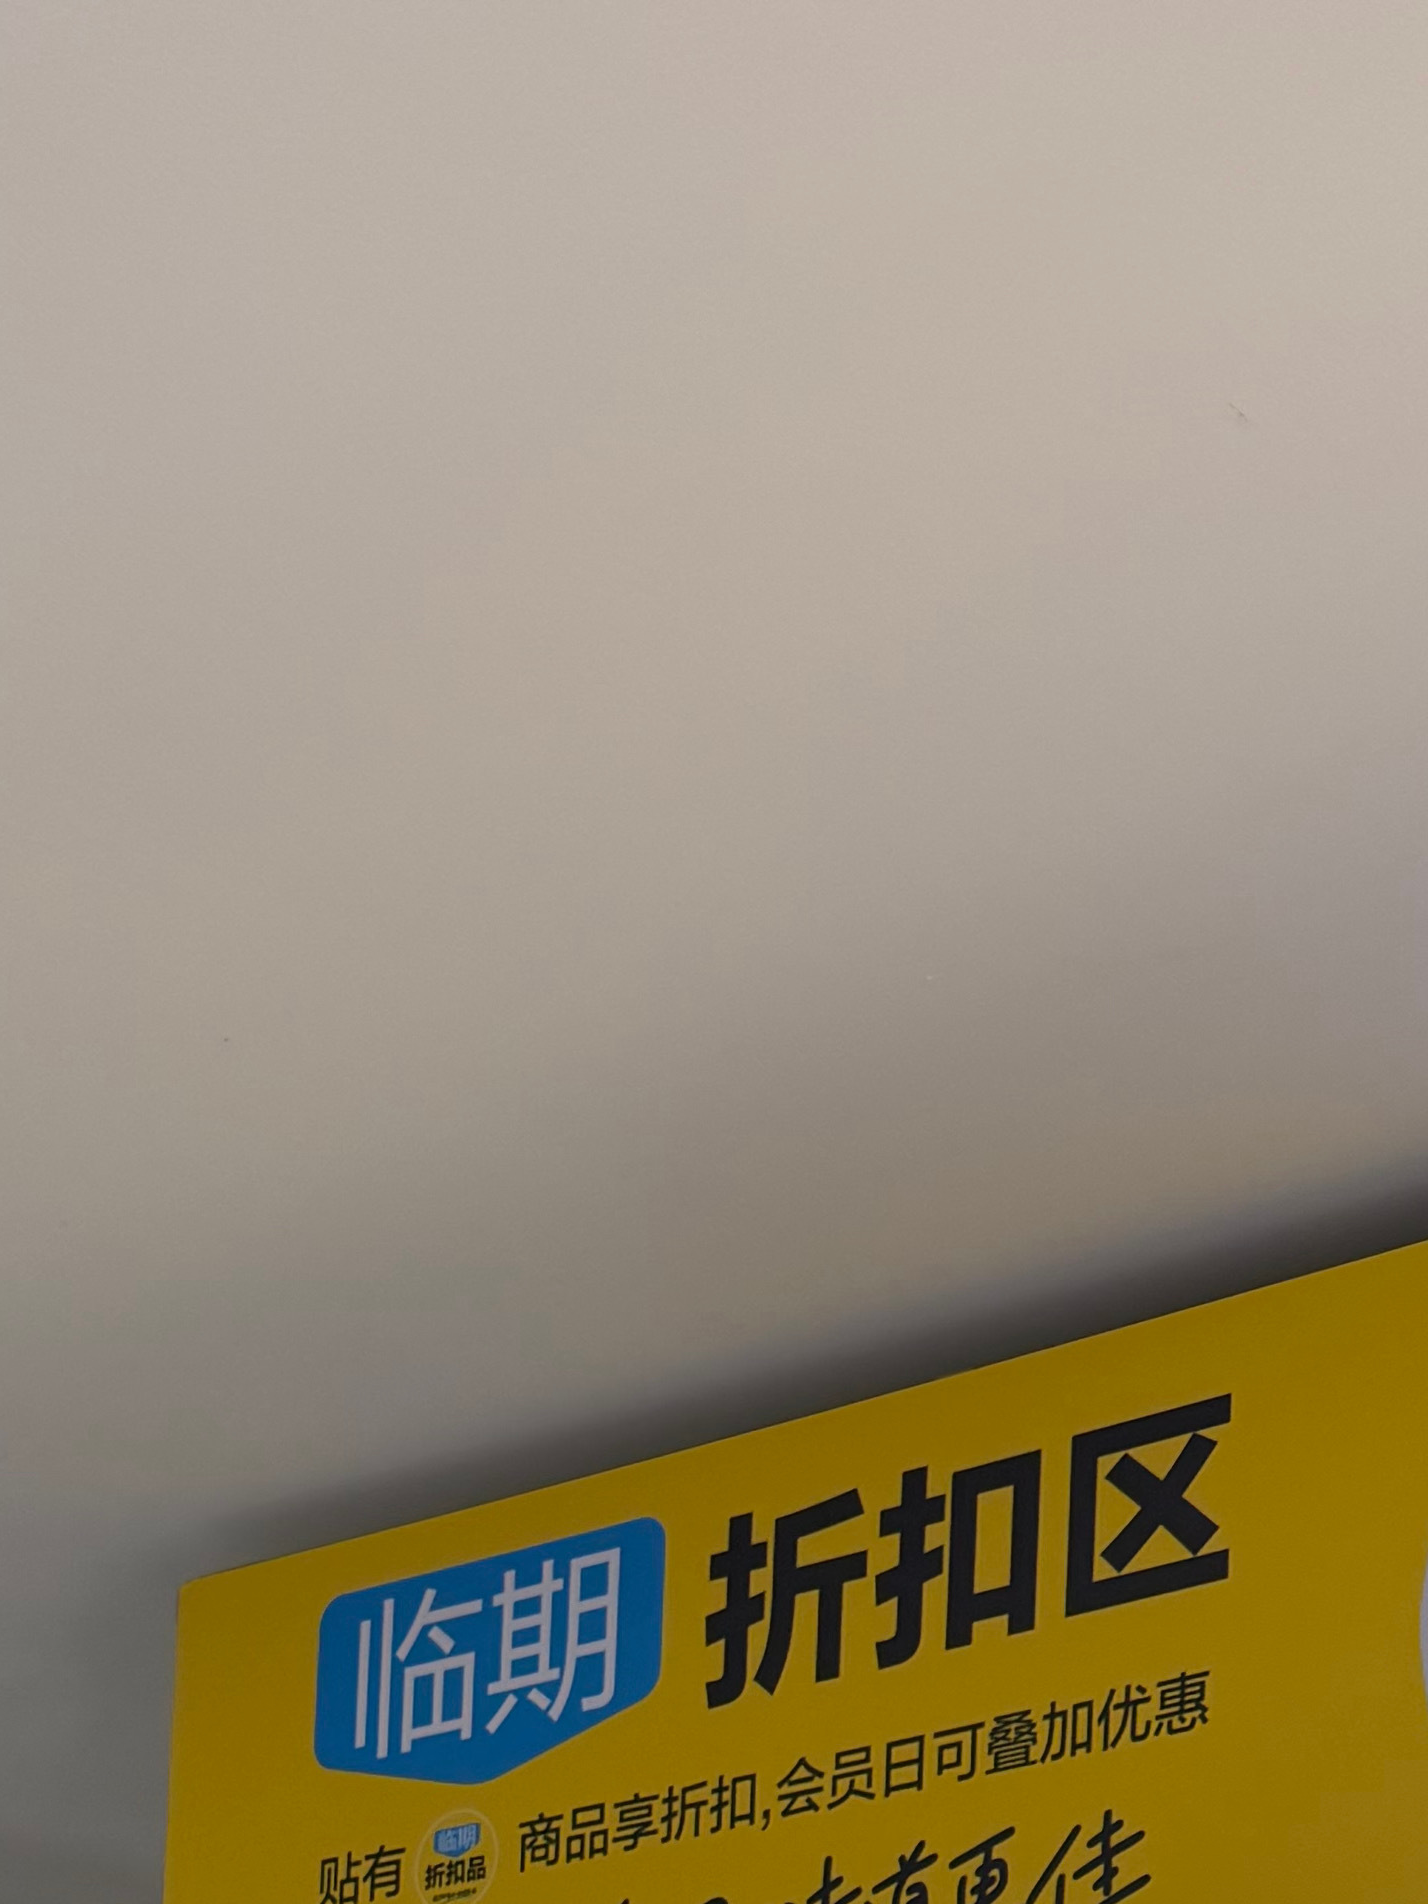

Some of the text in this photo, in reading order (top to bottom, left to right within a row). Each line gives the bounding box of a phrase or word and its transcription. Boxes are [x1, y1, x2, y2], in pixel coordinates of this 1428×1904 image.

[353, 1392, 1232, 1760] 临期 折扣区
[424, 1852, 487, 1891] 折扣品
